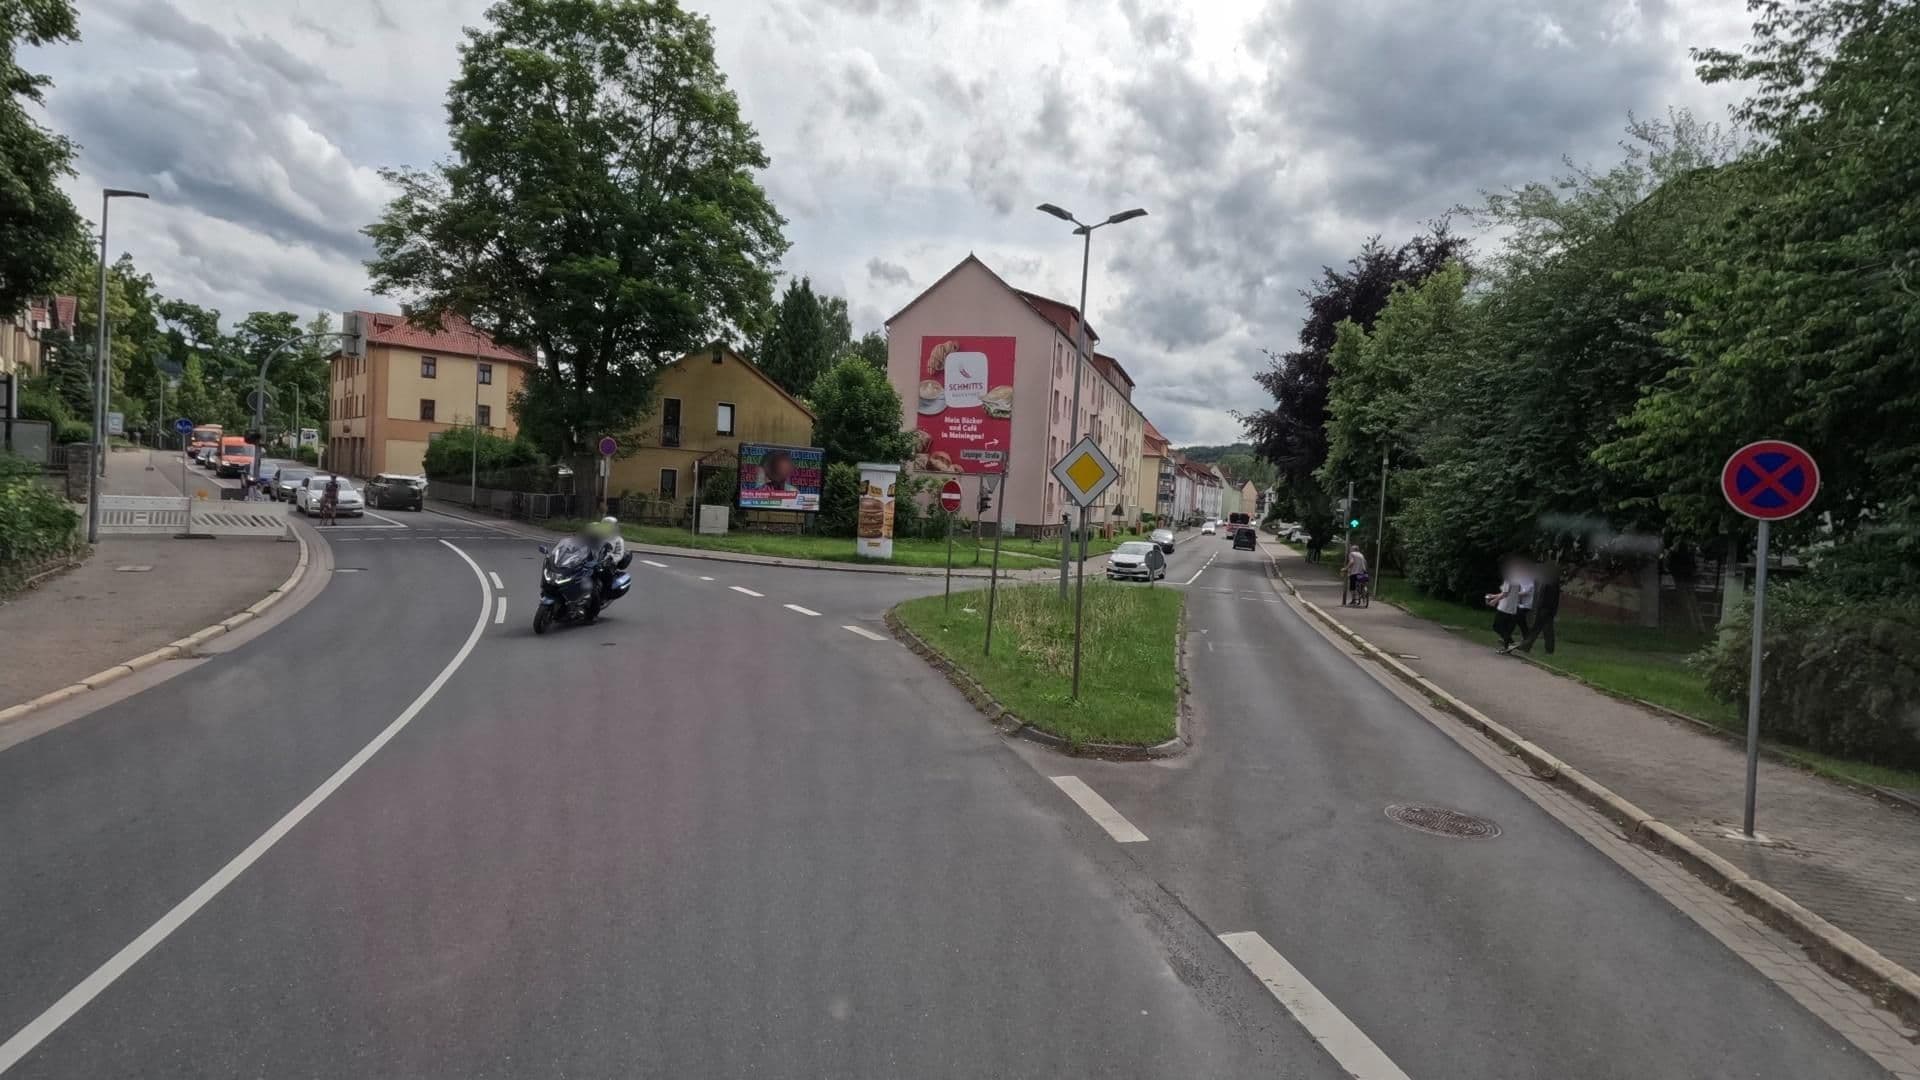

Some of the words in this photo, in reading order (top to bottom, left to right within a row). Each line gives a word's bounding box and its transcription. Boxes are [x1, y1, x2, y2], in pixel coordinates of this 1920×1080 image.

[944, 416, 961, 424] Mein
[961, 416, 983, 425] Bäcker
[962, 424, 978, 432] Café
[949, 431, 985, 442] Meiningen!
